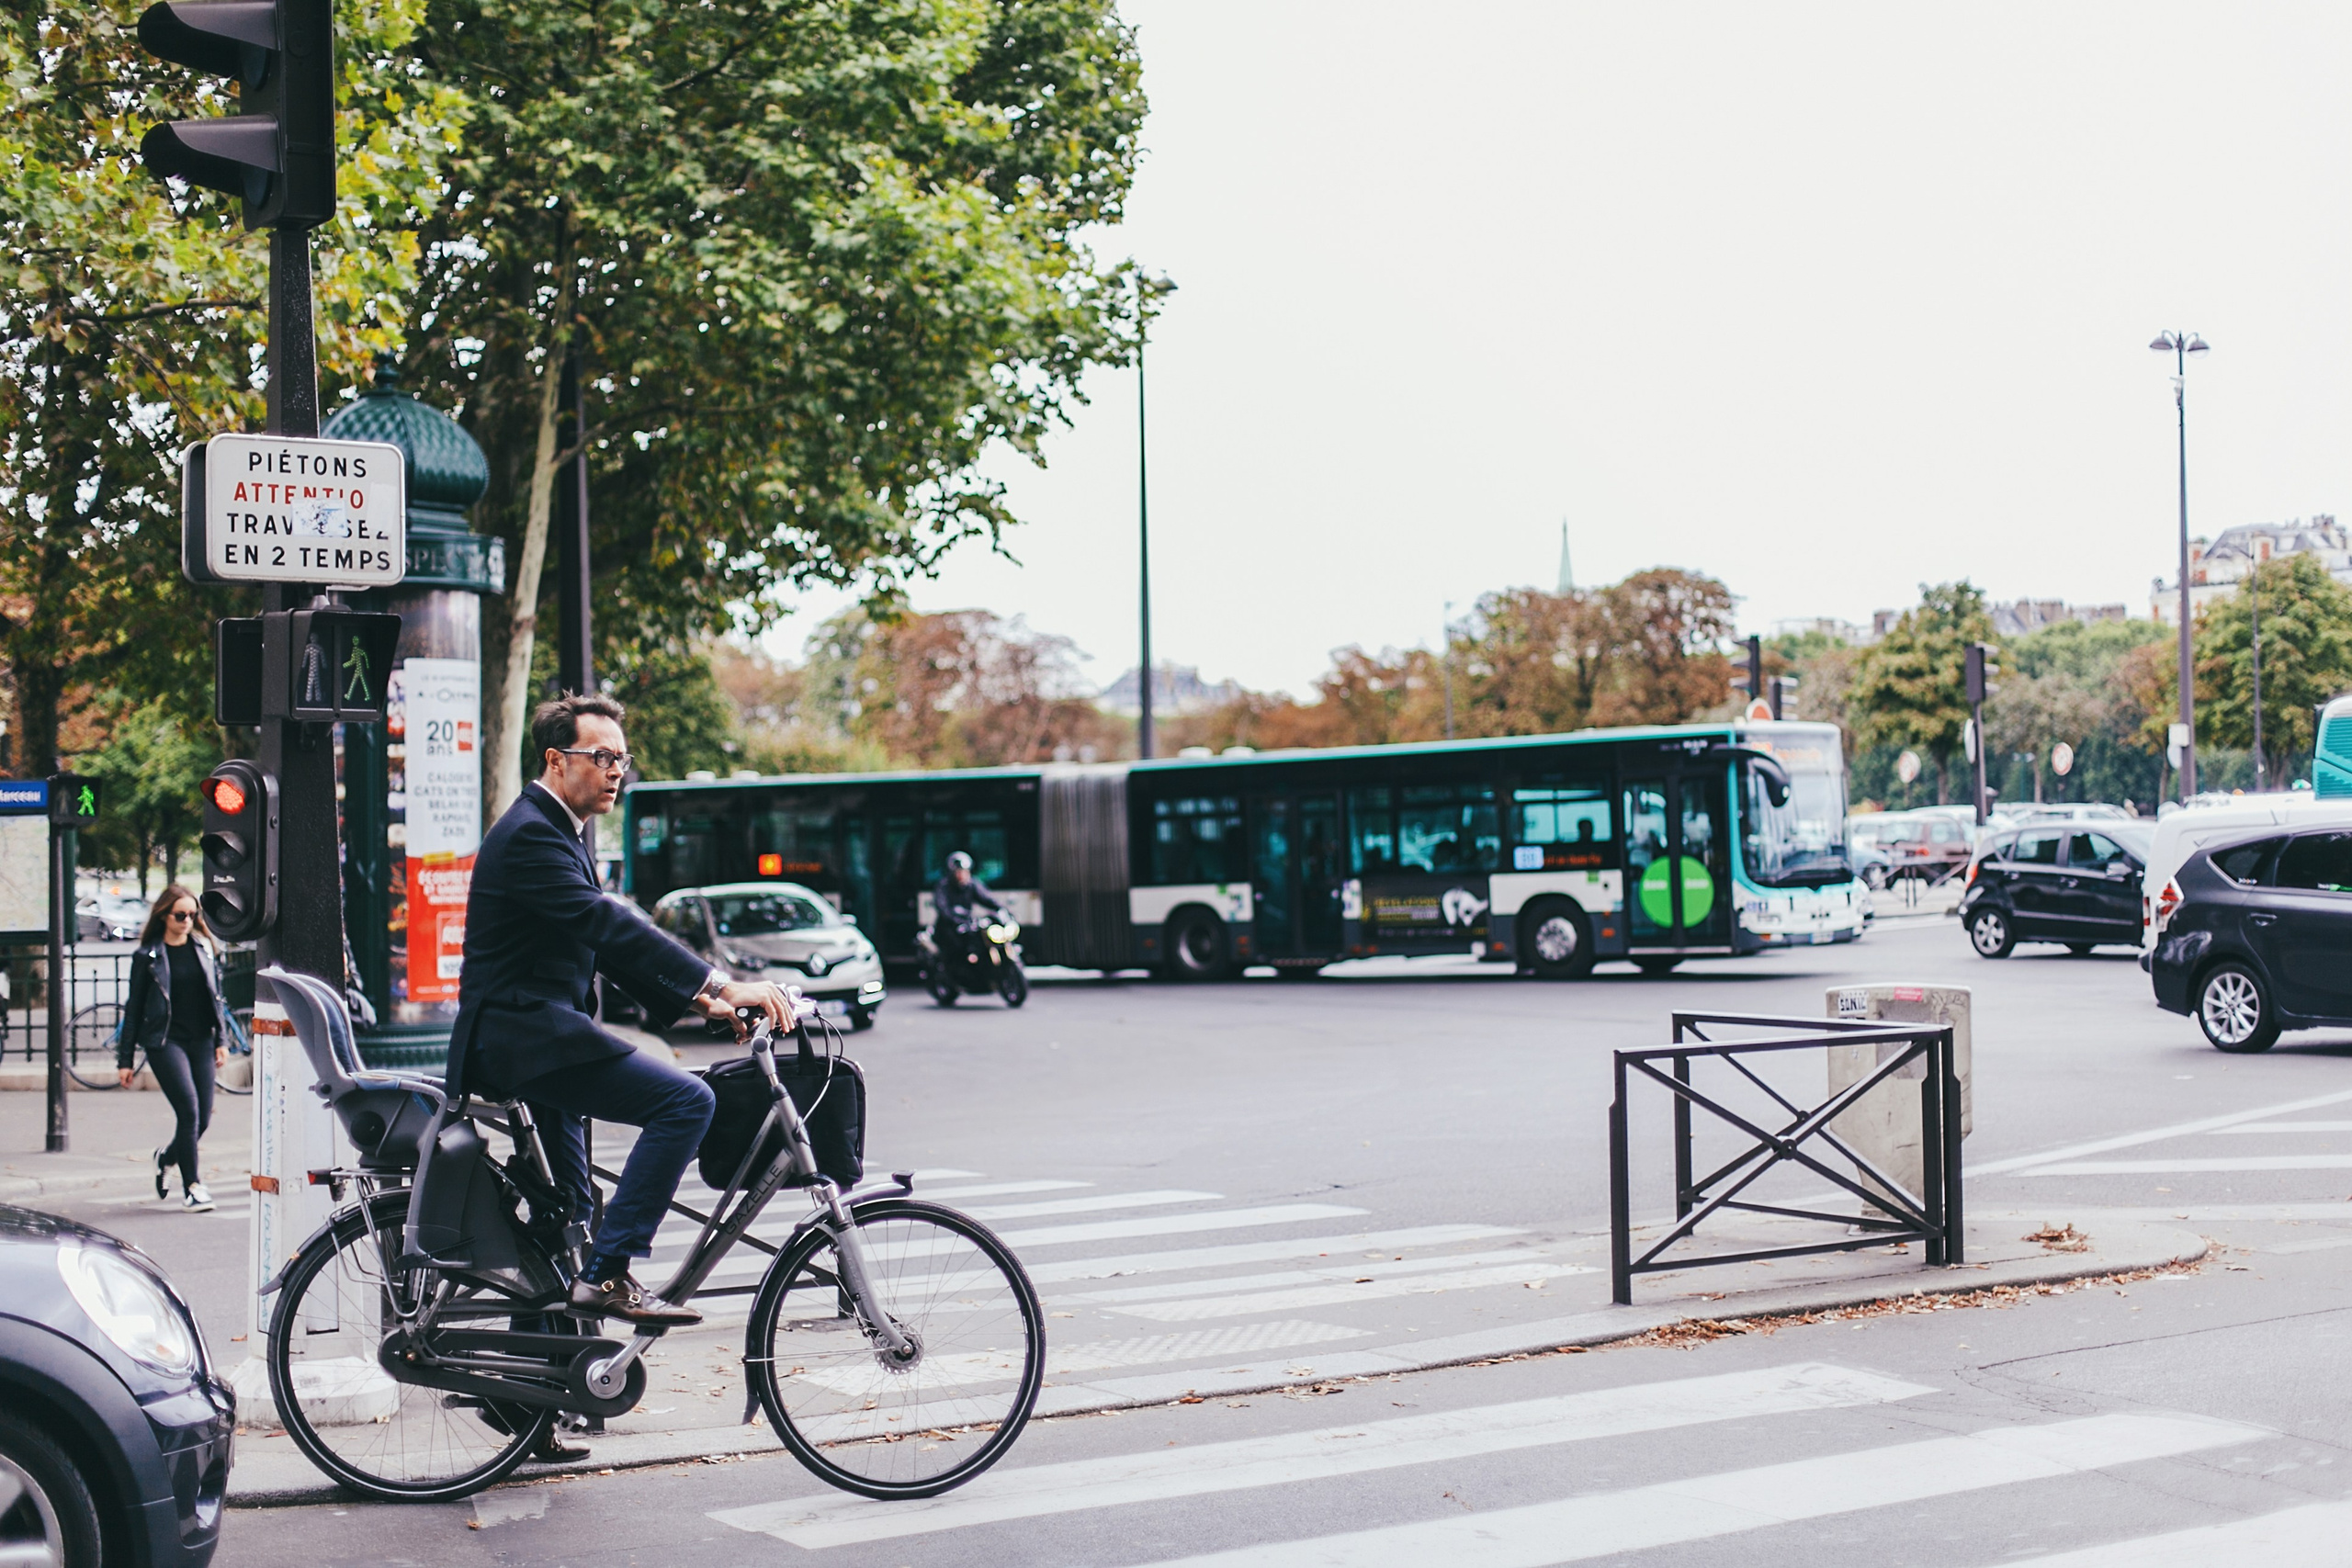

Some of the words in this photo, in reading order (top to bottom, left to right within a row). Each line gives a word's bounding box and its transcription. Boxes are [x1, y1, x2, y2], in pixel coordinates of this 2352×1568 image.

[248, 448, 368, 479] PIÉTONS
[233, 480, 364, 509] ATTENTIO
[224, 544, 259, 565] EN
[272, 546, 286, 566] 2
[299, 547, 390, 570] TEMPS
[425, 719, 454, 742] 20
[426, 742, 453, 756] ans
[725, 1164, 783, 1235] GAZELLE
